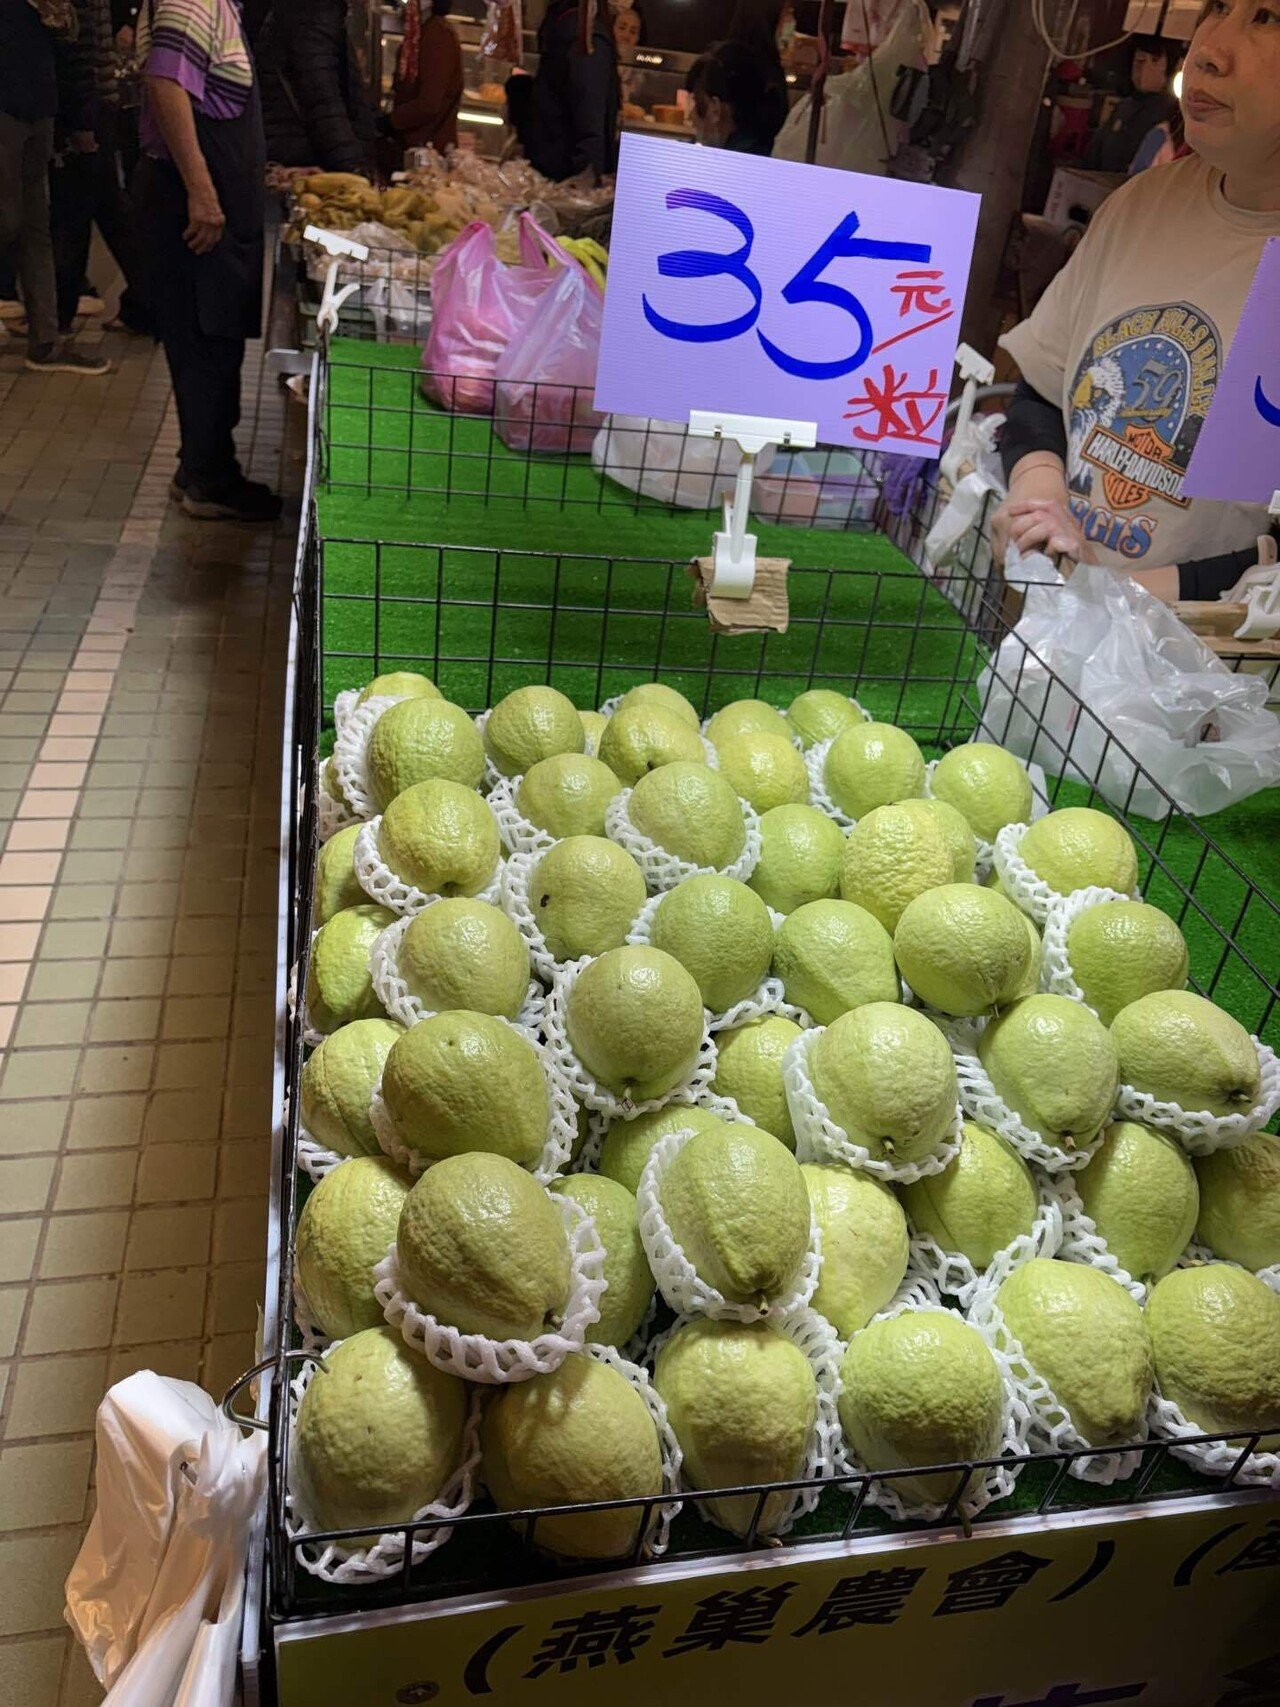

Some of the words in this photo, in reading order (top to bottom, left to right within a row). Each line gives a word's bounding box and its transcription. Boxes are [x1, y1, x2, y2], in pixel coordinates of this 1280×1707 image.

[642, 188, 932, 380] 35
[1128, 431, 1162, 460] MOTOR
[463, 1539, 1116, 1696] (燕巢農會)
